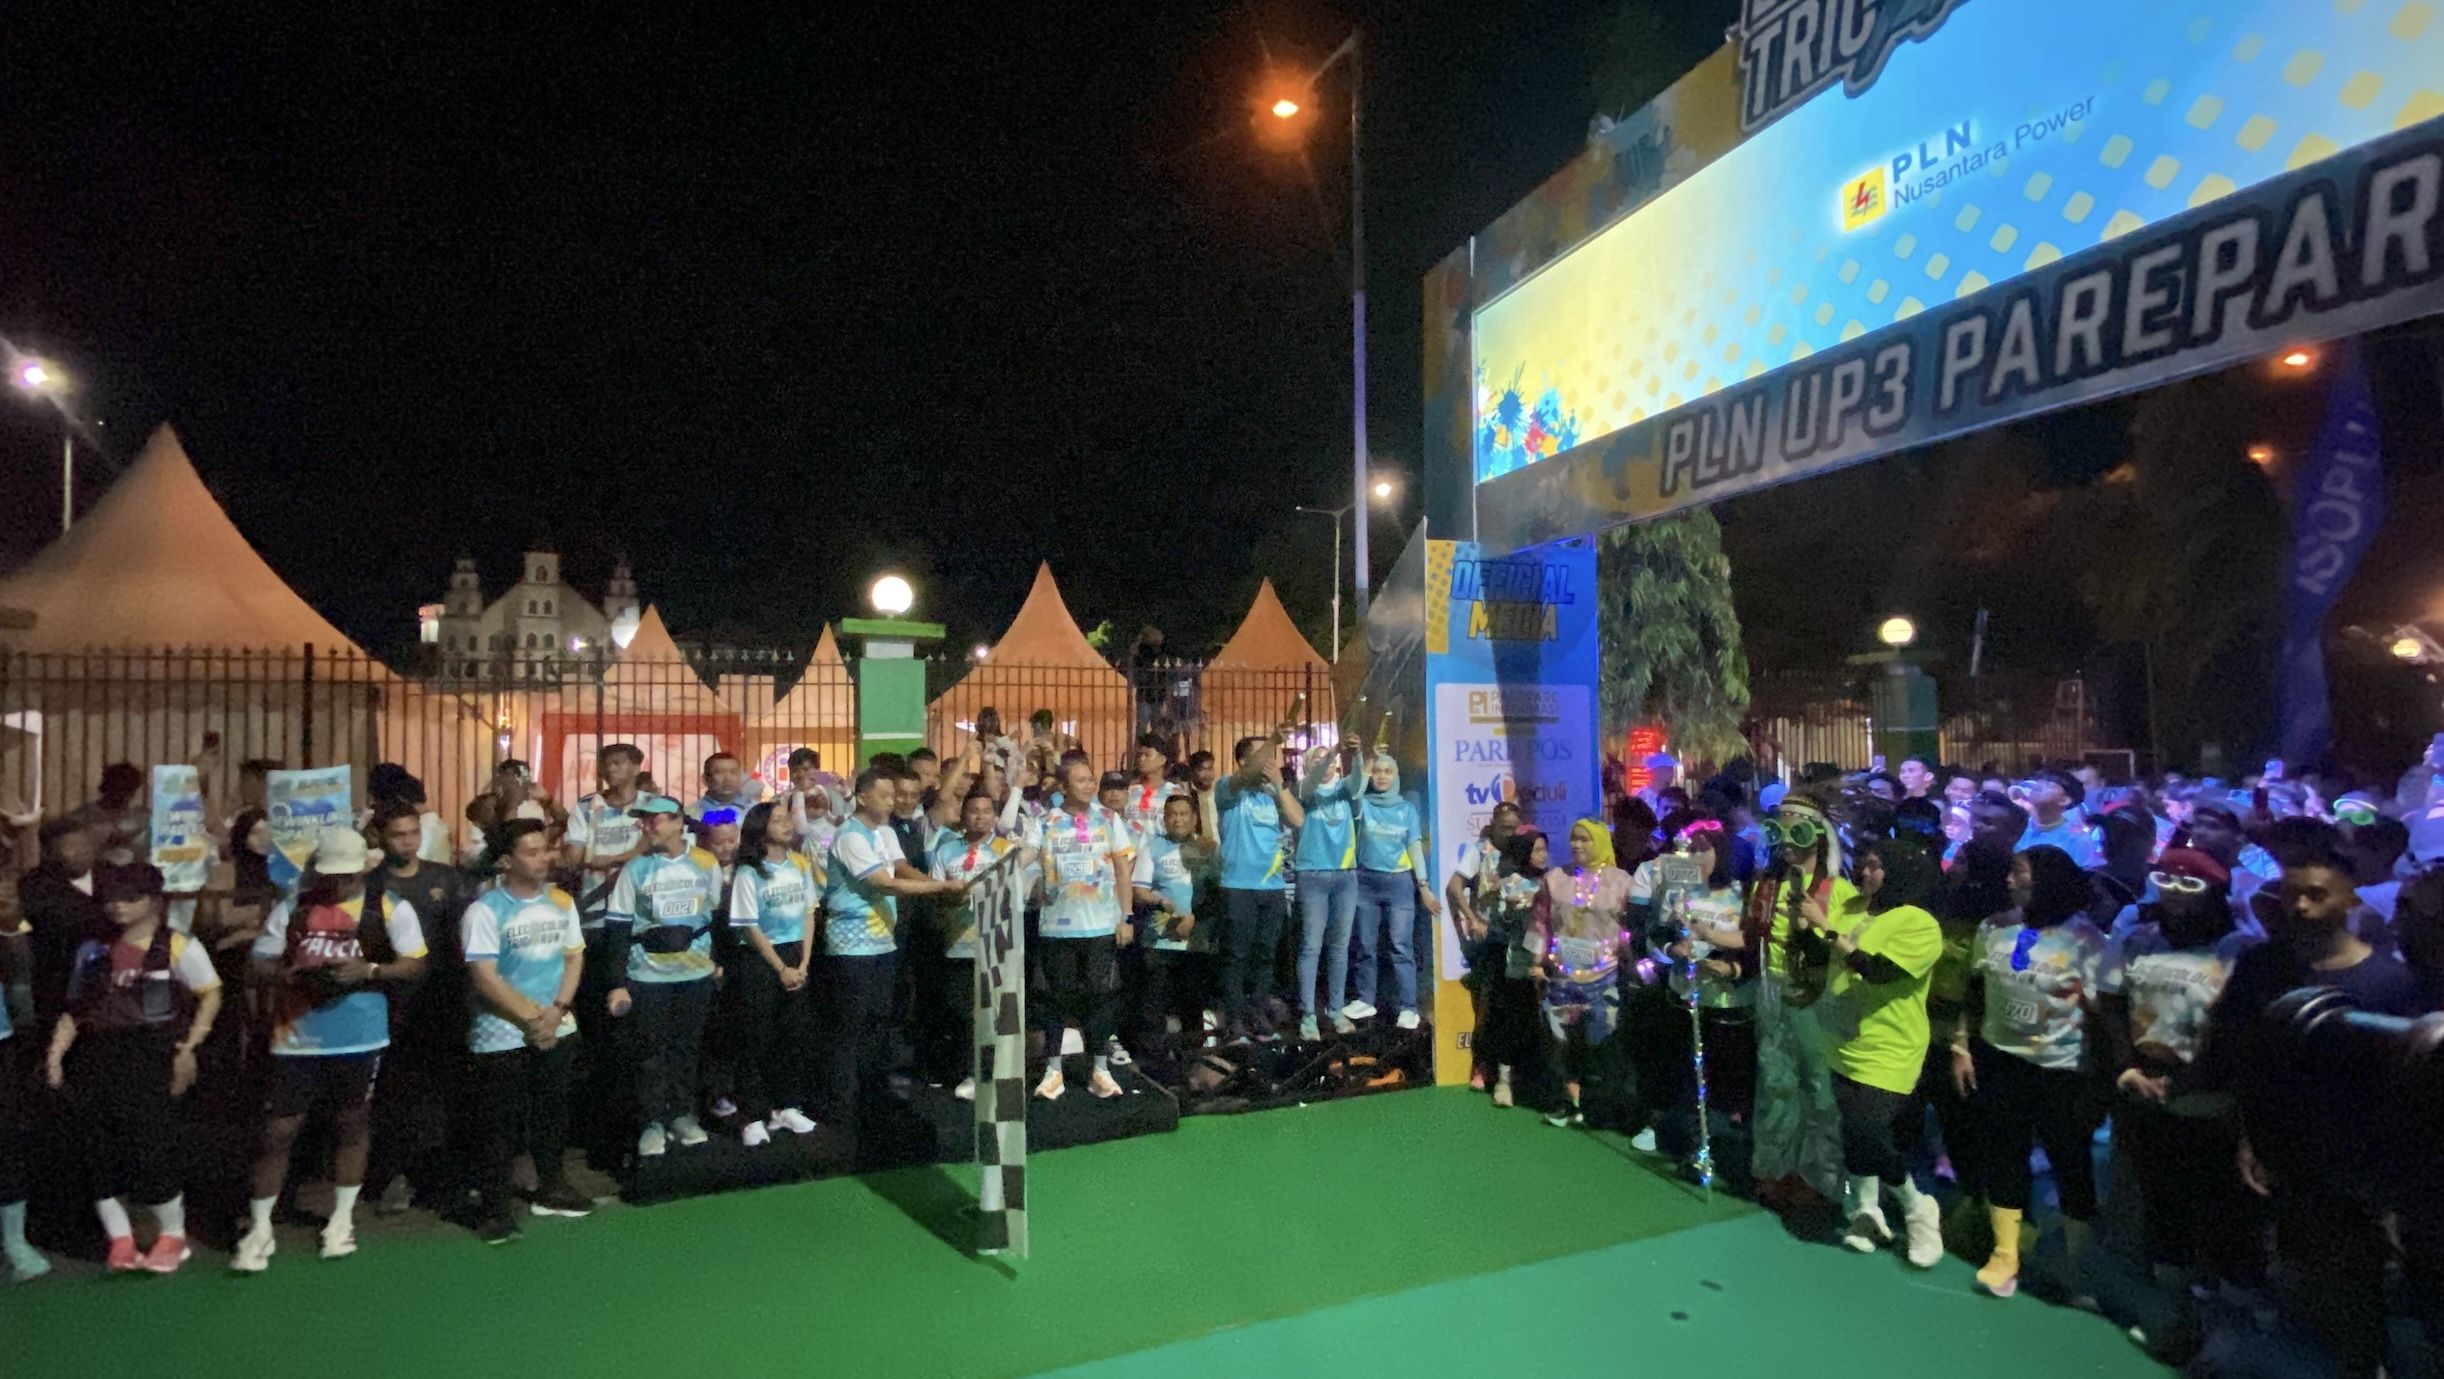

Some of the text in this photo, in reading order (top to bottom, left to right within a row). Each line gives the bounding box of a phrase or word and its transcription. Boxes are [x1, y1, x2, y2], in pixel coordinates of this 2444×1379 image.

[1750, 0, 1877, 116] TRIC
[1892, 119, 1971, 184] PLN
[1893, 95, 2095, 209] Nusantara Power
[1665, 396, 1763, 492] PLN
[1785, 344, 1910, 456] UP3
[1451, 560, 1575, 605] OFFICIAL
[1467, 599, 1559, 641] MEDIA
